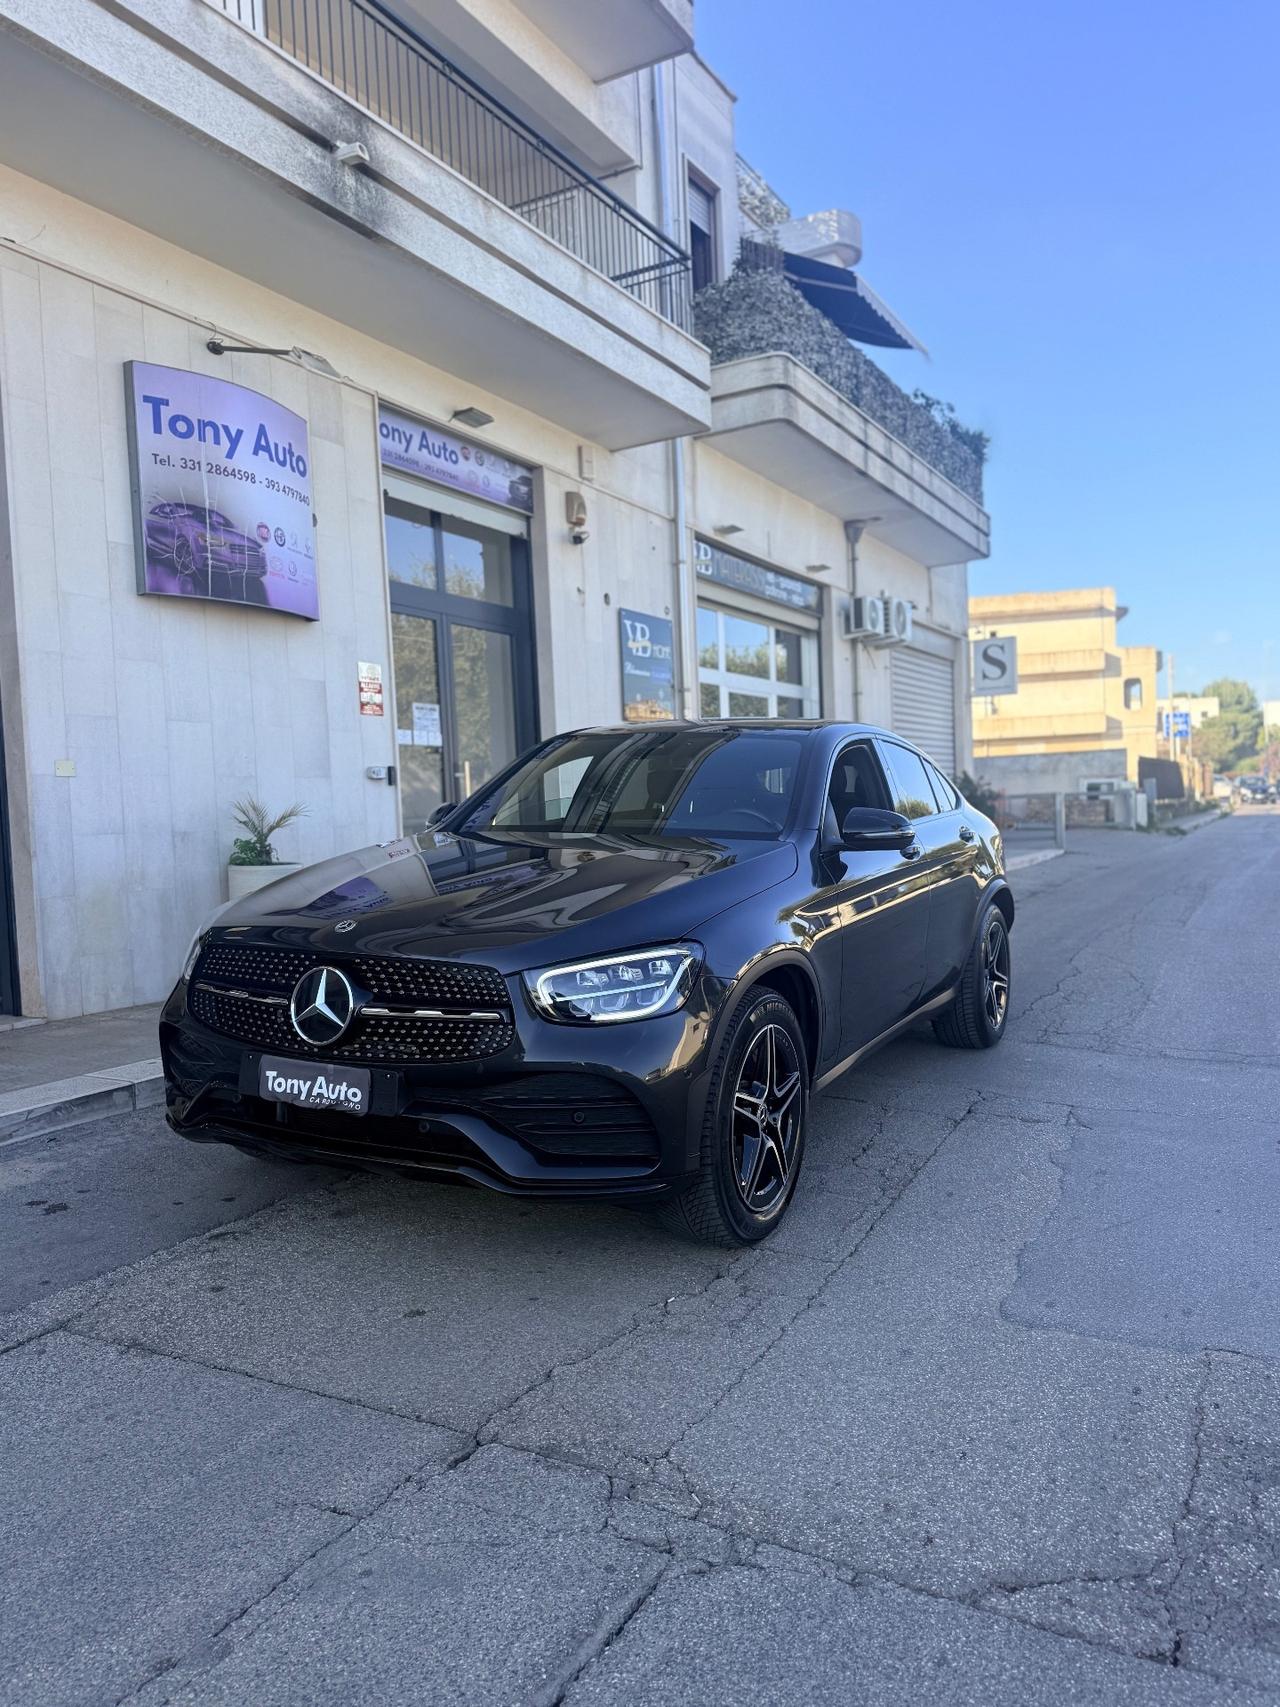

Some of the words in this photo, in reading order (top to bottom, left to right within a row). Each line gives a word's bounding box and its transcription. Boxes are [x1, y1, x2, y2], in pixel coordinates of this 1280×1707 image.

[143, 395, 243, 460] Tony
[252, 423, 308, 479] Auto
[418, 430, 459, 465] Auto
[151, 453, 176, 468] Tel.
[180, 457, 202, 472] 331
[206, 462, 257, 485] 2864598
[265, 477, 281, 493] 393
[982, 643, 1007, 681] S
[265, 1071, 312, 1101] Tony
[312, 1076, 363, 1103] Auto
